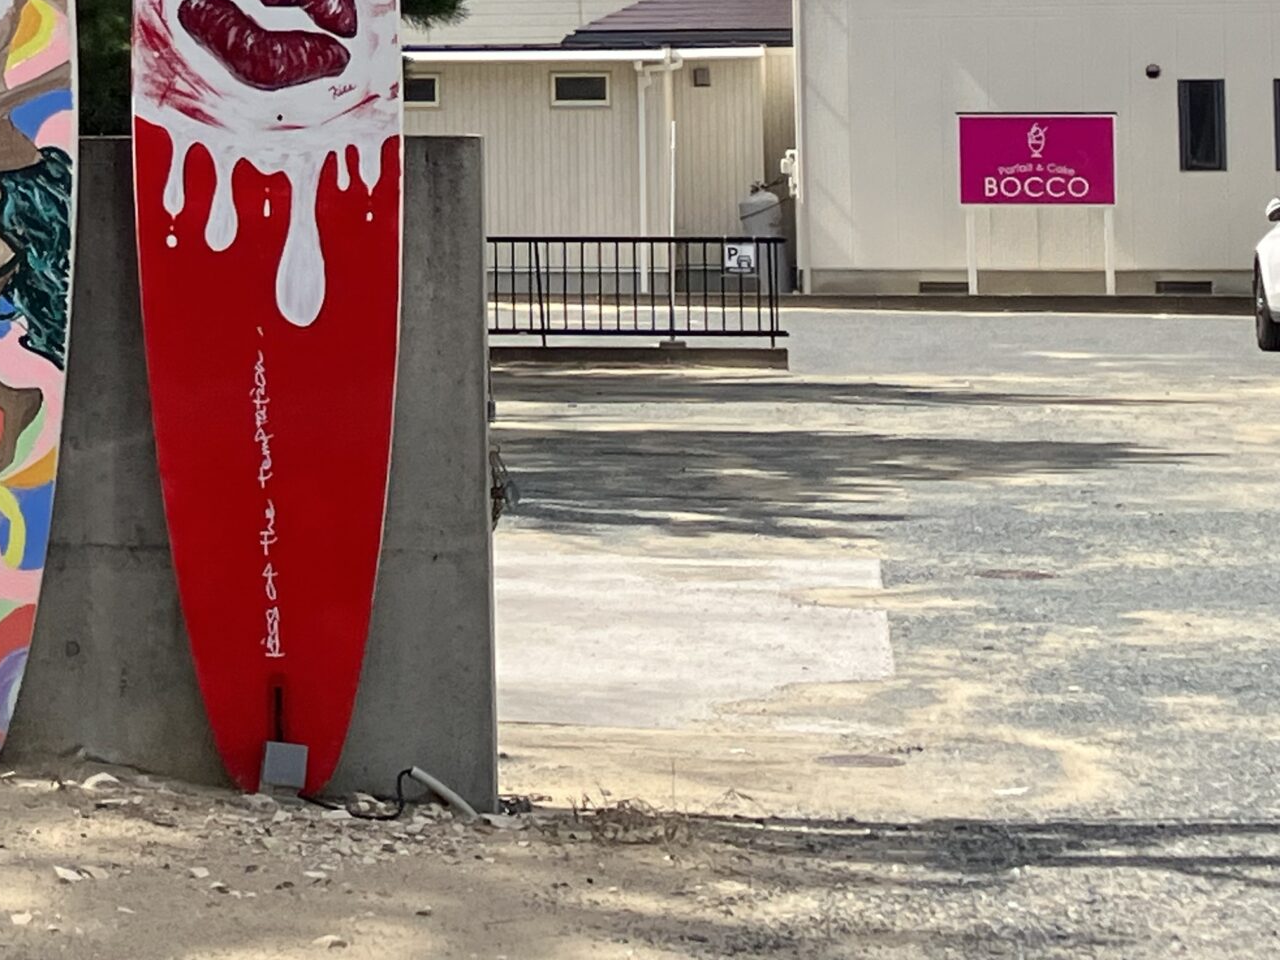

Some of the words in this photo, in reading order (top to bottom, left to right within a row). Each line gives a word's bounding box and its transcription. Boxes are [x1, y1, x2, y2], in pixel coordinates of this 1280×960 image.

[997, 163, 1033, 176] Parfait
[1036, 163, 1044, 172] &
[1047, 163, 1075, 176] Cake
[984, 176, 1090, 198] BOCCO
[727, 246, 738, 261] P
[259, 498, 279, 556] the
